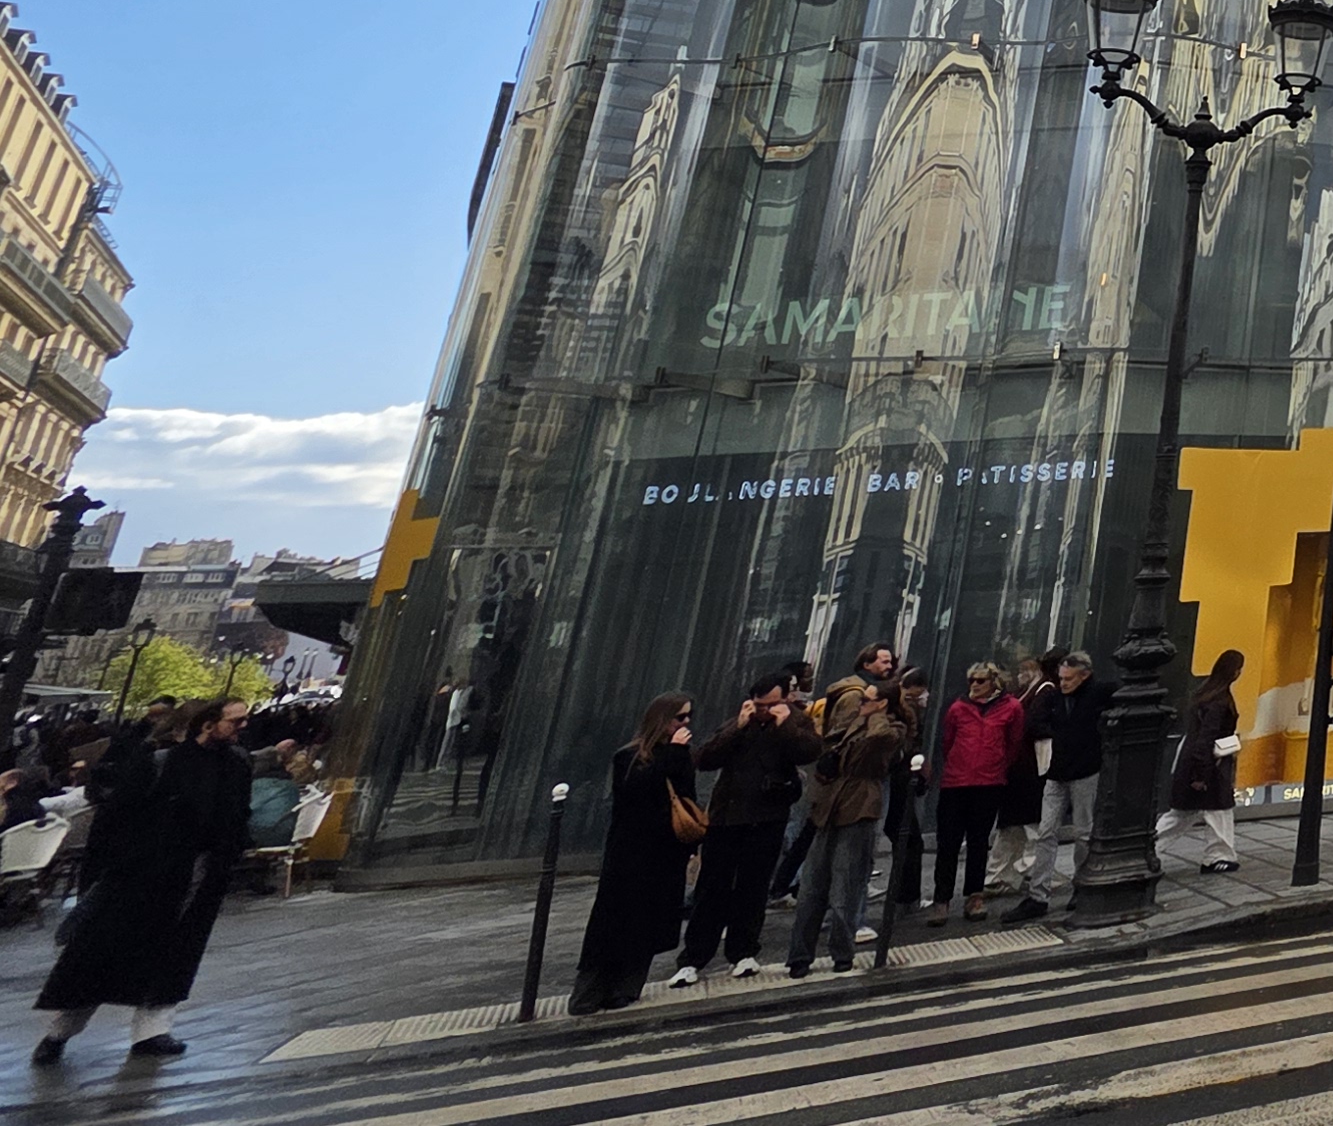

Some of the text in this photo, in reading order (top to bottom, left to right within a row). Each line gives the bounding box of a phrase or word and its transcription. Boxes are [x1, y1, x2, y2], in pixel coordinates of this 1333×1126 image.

[700, 285, 1071, 349] SAMARITANE
[642, 476, 836, 505] BOULNGERIE
[866, 471, 922, 492] BAR
